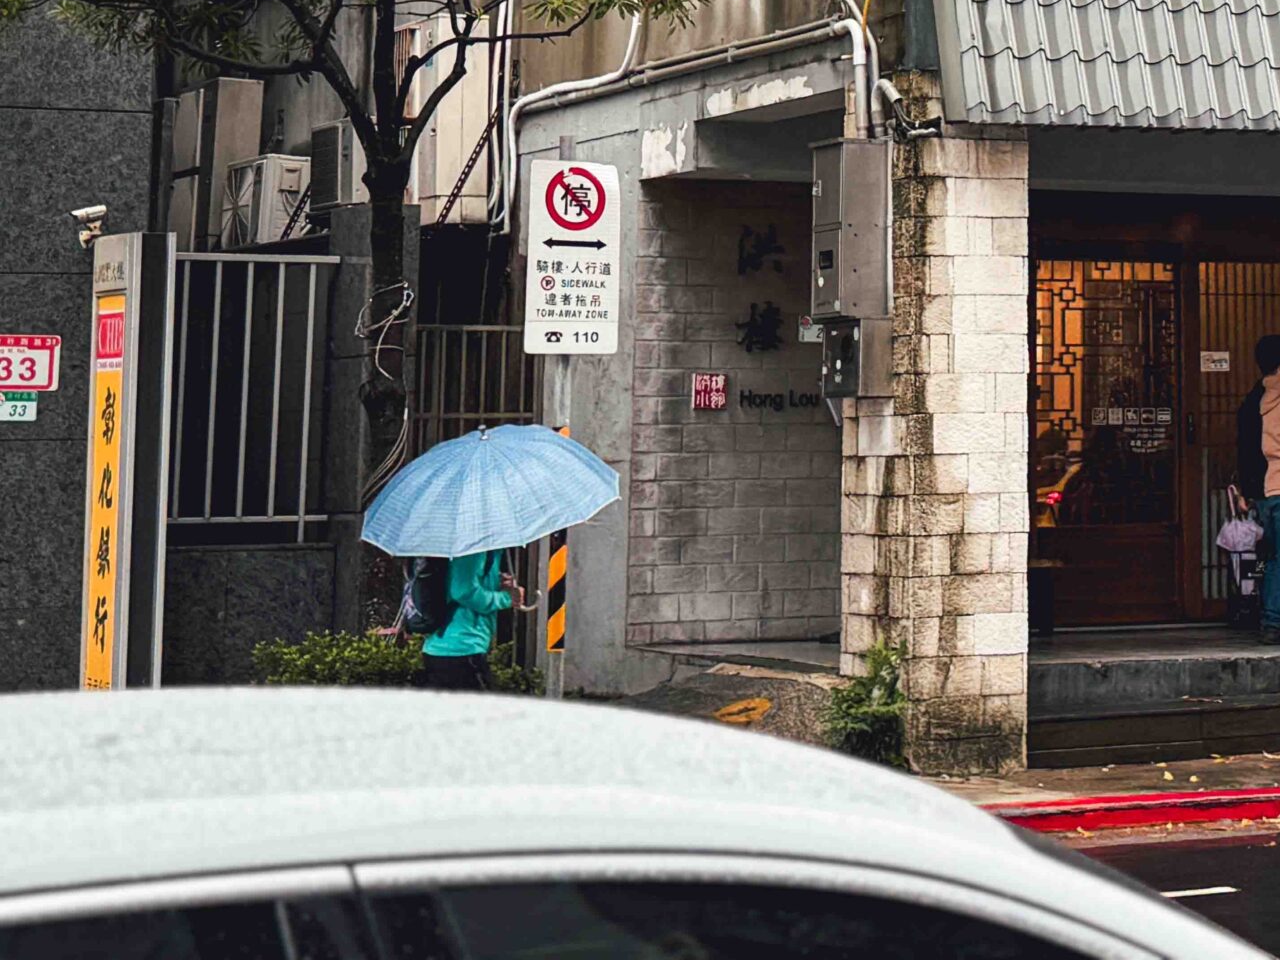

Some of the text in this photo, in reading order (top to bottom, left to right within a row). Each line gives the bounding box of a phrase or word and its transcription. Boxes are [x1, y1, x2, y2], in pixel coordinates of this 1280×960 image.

[561, 279, 607, 289] SIDEWALK
[536, 308, 609, 320] TOW-AWAY ZONE
[573, 331, 600, 344] 110
[739, 389, 820, 410] Hong Lou
[9, 404, 27, 418] 33
[92, 386, 117, 654] 彰化銀行
